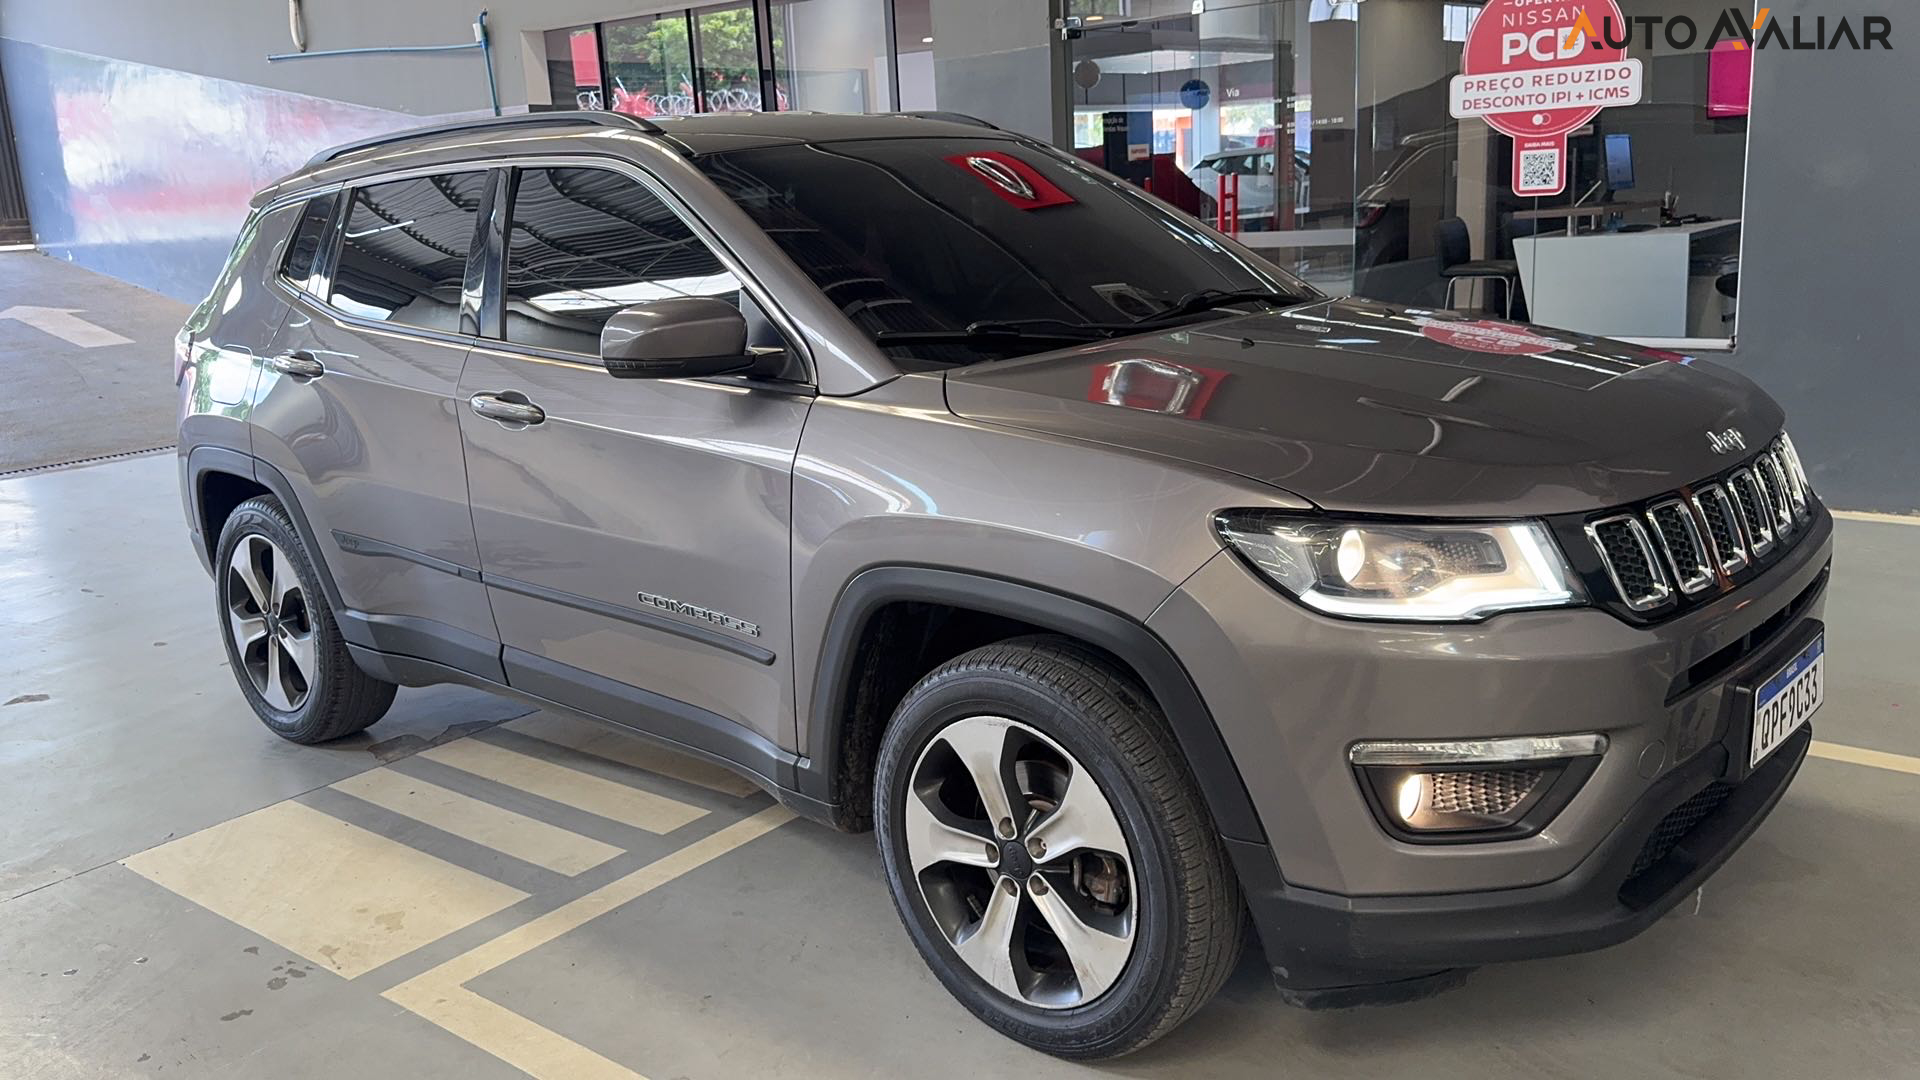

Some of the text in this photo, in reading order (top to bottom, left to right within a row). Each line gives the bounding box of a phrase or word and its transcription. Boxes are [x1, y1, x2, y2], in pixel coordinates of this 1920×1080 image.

[1502, 5, 1585, 28] NISSAN
[1502, 26, 1585, 65] PCD
[1226, 88, 1240, 97] Via
[1464, 67, 1632, 93] PREÇO REDUZIDO
[1462, 86, 1630, 111] DESCONTO IPI + ICMS
[1706, 427, 1746, 454] Jeep
[637, 591, 761, 638] COMPASS
[1761, 664, 1818, 750] QPF9C33
